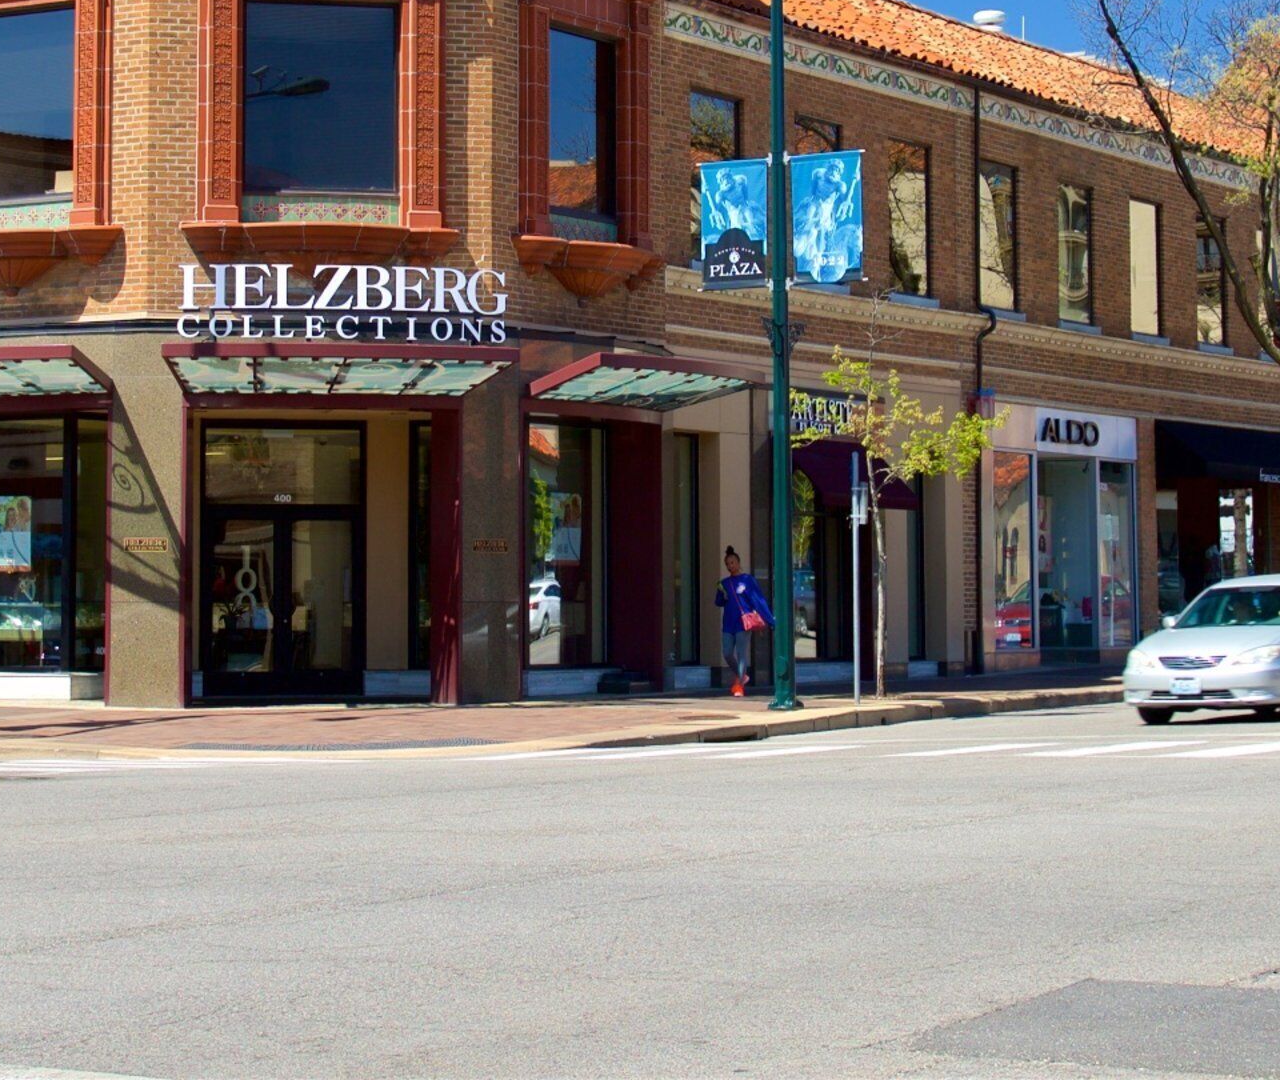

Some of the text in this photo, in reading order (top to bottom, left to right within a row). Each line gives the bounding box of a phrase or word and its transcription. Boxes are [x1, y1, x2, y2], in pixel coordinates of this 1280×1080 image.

[709, 261, 763, 278] PLAZA
[177, 263, 509, 316] HELZBERG
[176, 314, 508, 344] COLLECTIONS
[1040, 417, 1100, 447] ALDO
[274, 494, 292, 503] 400
